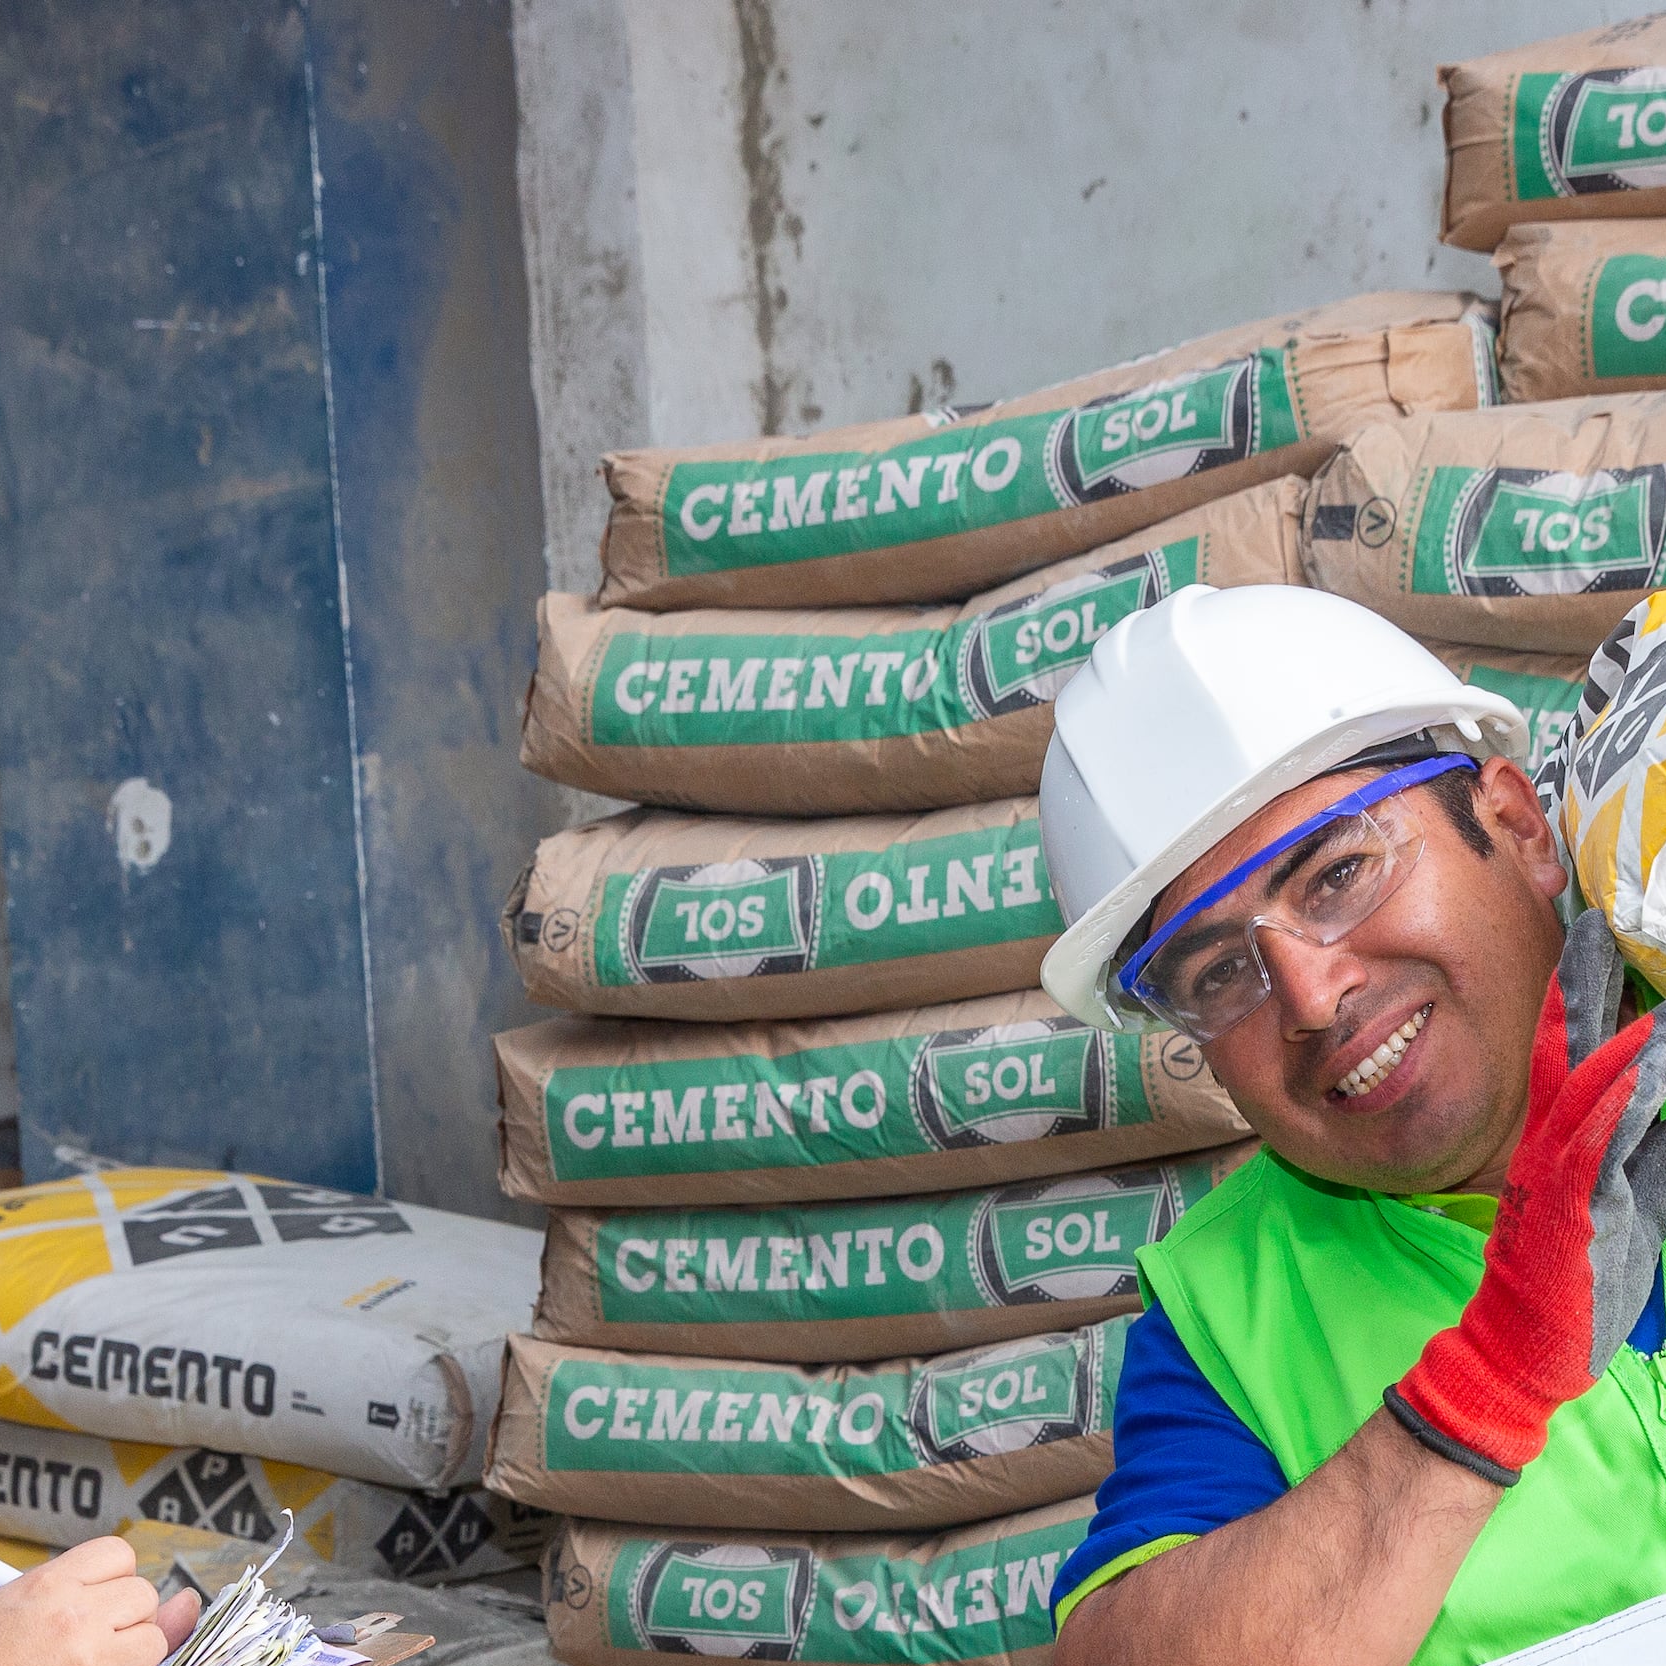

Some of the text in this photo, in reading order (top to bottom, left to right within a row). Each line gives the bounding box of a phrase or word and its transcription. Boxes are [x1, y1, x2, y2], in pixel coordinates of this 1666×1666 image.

[680, 393, 1197, 543] CEMENTO SOL
[1512, 504, 1612, 553] SOL
[615, 601, 1107, 716] CEMENTO SOL
[675, 845, 1060, 943] ENTO SOL
[563, 1053, 1056, 1151] CEMENTO SOL
[616, 1211, 1120, 1294] CEMENTO SOL
[32, 1330, 277, 1418] CEMENTO
[563, 1365, 1046, 1445] CEMENTO SOL
[682, 1548, 1068, 1631] MENTO SOL
